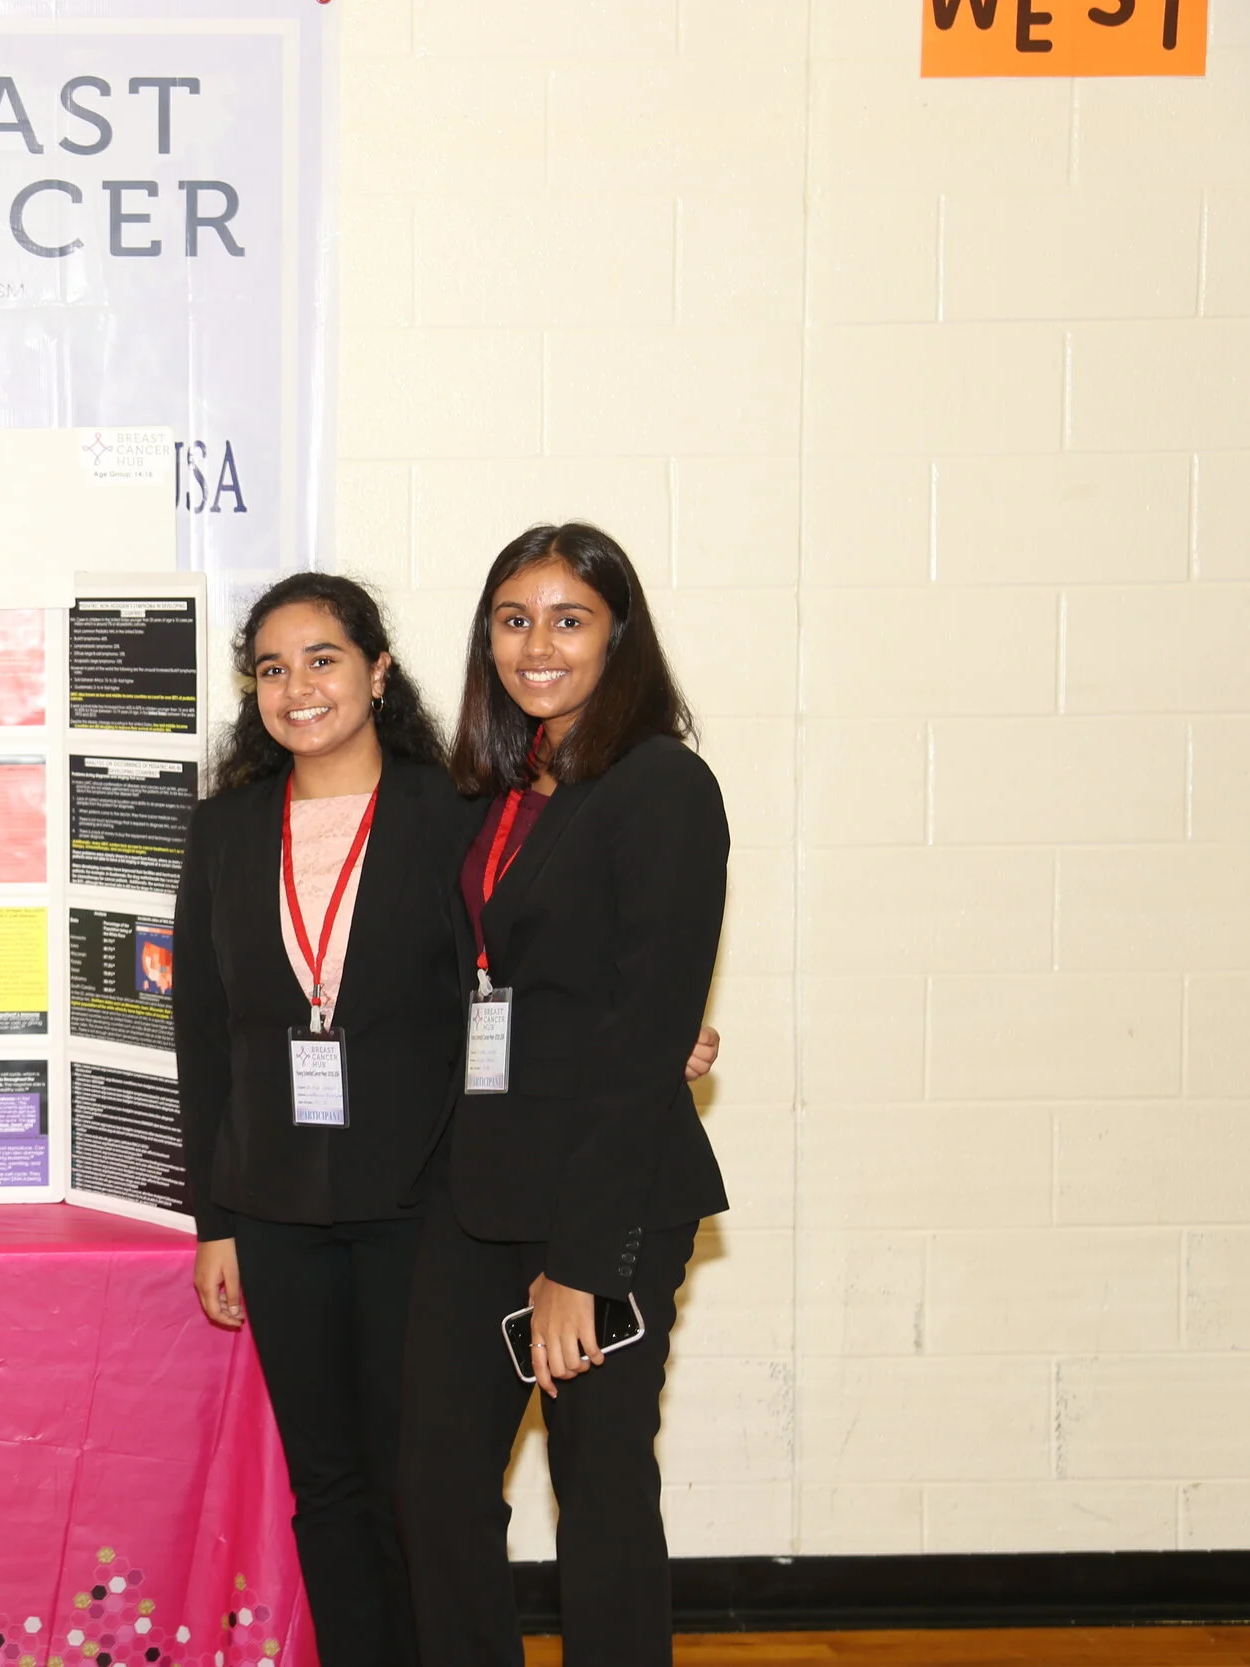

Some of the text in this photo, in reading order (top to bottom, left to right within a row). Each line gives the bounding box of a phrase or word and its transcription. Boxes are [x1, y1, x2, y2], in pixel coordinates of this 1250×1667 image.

[117, 434, 164, 442] BREAST
[117, 446, 169, 455] CANCER
[117, 458, 143, 466] HUB
